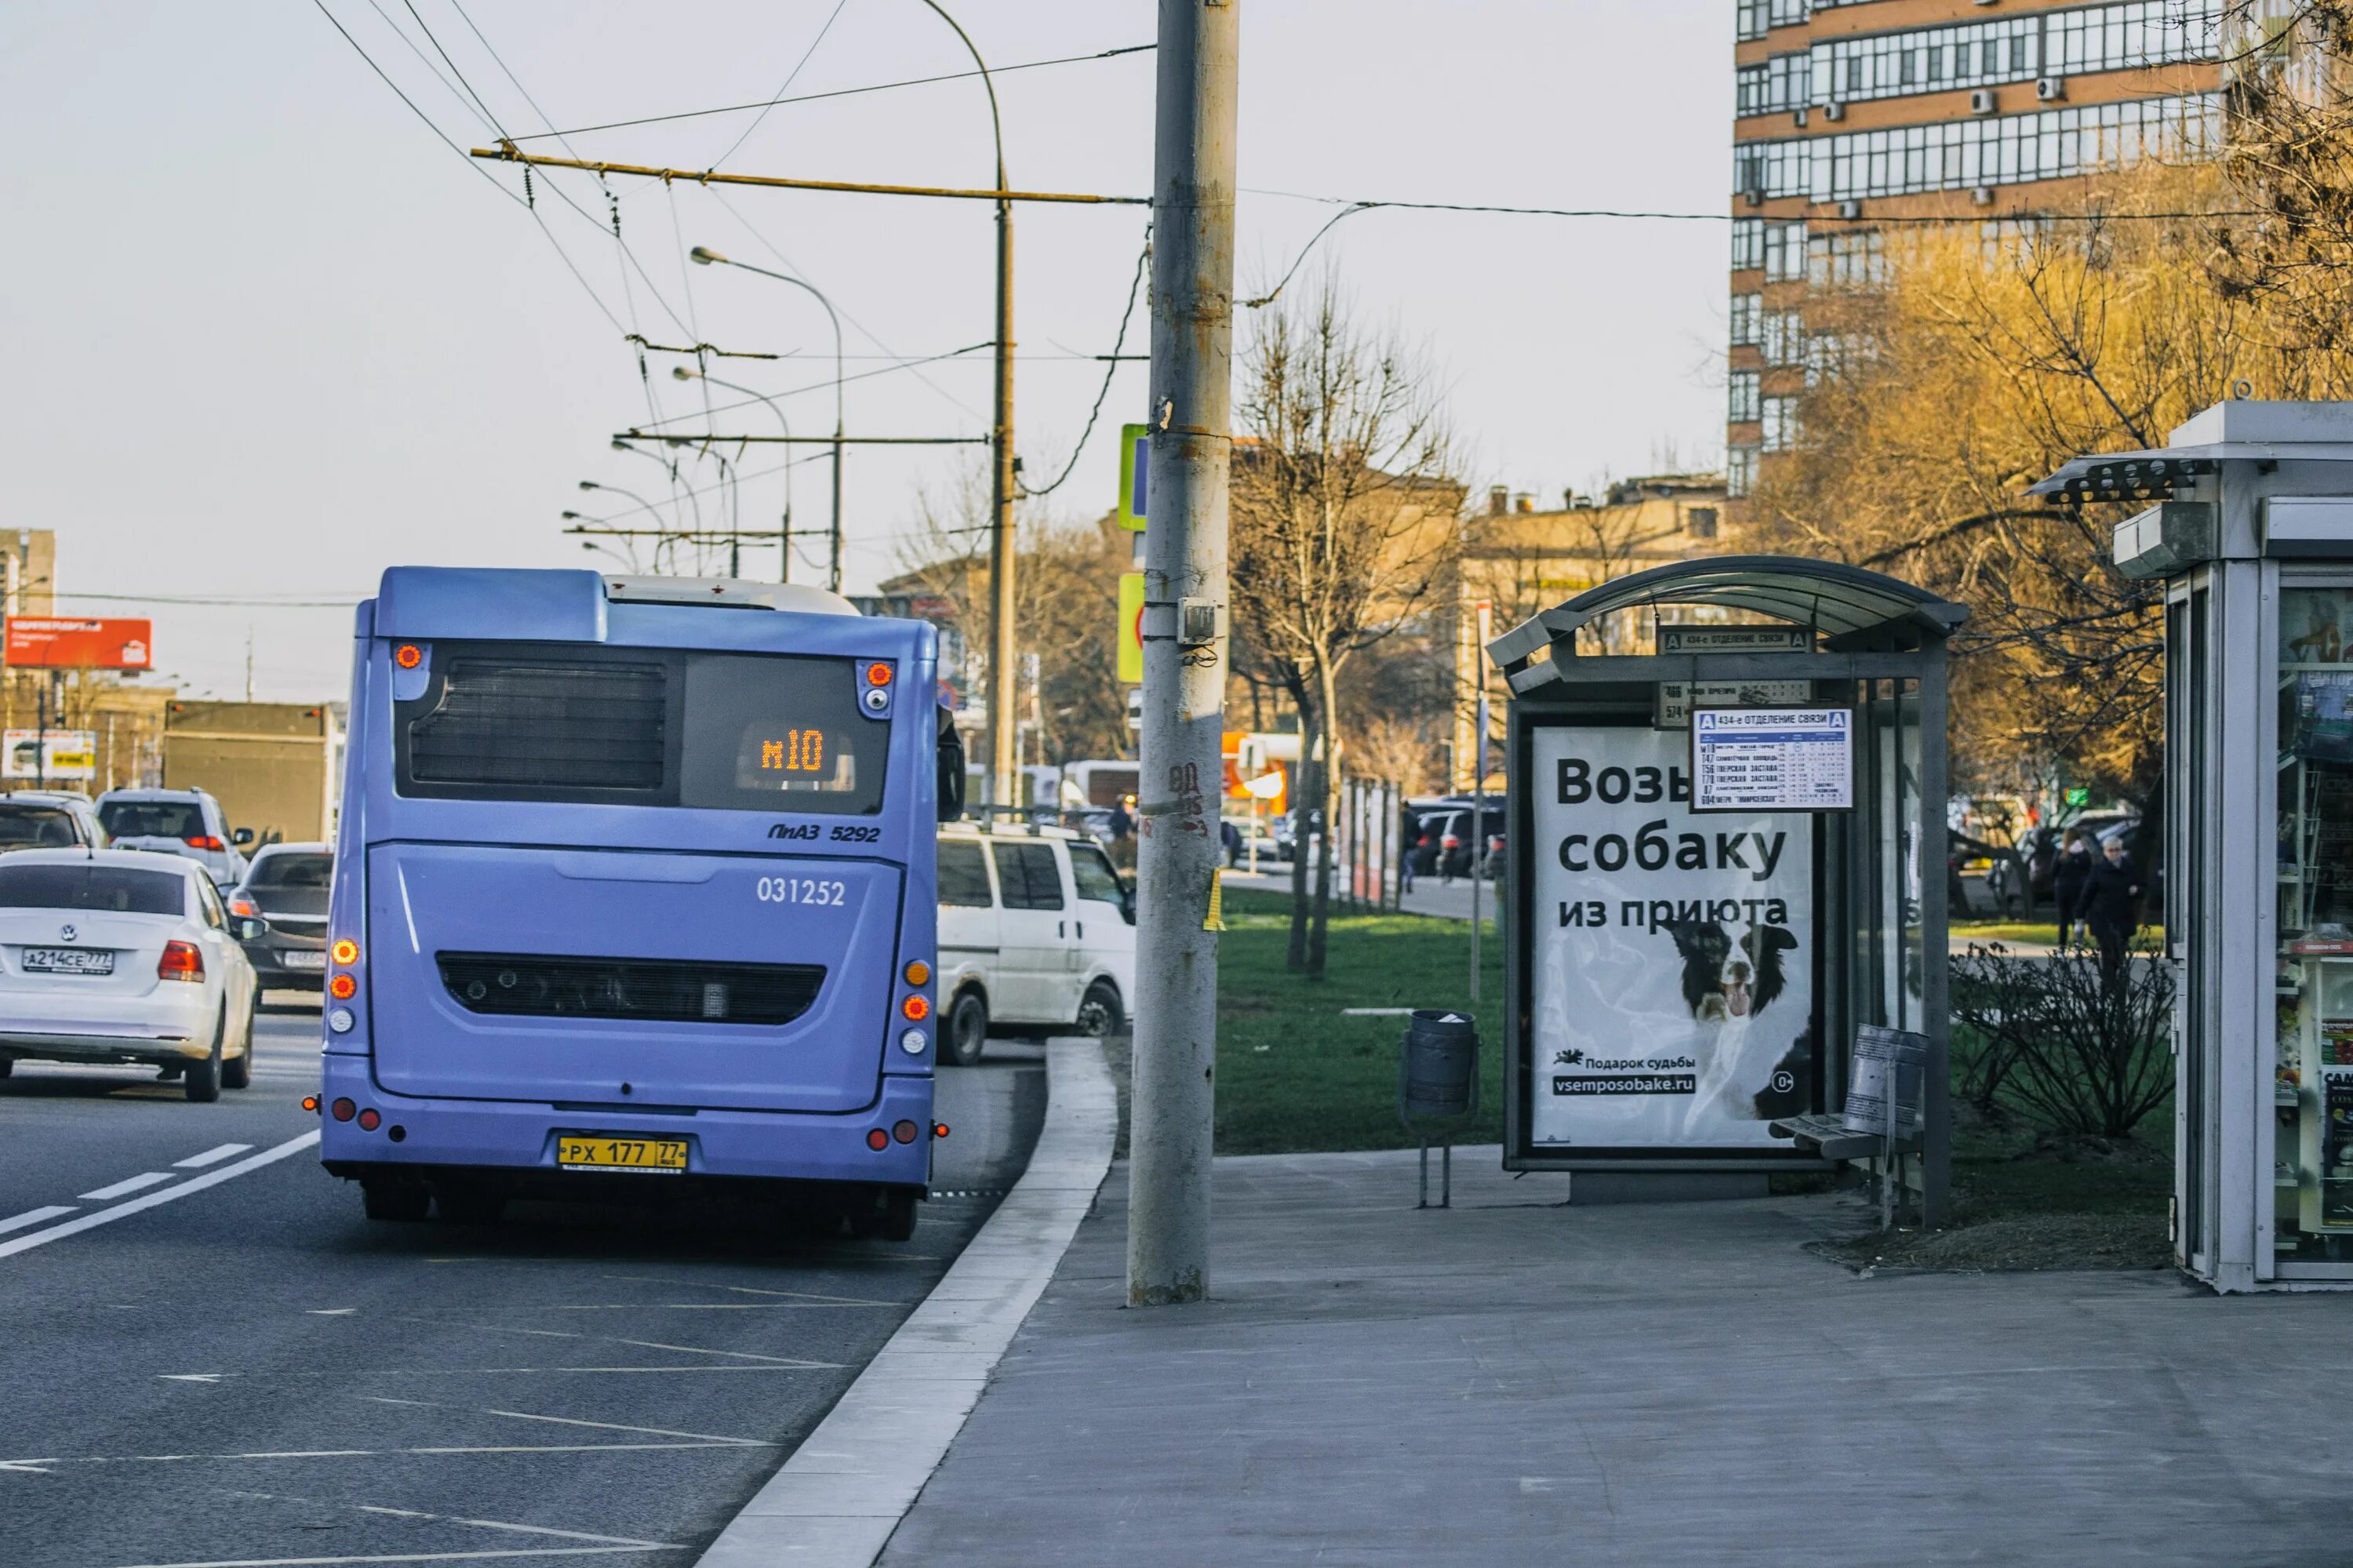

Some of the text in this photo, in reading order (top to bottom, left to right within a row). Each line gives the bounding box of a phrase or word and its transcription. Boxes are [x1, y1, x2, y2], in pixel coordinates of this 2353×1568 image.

[1711, 634, 1755, 644] ОТДЕЛЕНИЕ
[1758, 634, 1784, 643] СВЯЗИ
[1718, 715, 1742, 726] 434-е
[1744, 714, 1796, 726] ОТДЕЛЕНИЕ
[1798, 713, 1827, 724] СВЯЗИ
[761, 729, 823, 771] м10
[1557, 758, 1689, 805] Возь
[830, 826, 881, 843] 5292
[1558, 818, 1787, 882] собаку
[757, 876, 846, 907] 031252
[1558, 897, 1788, 935] из приюта
[1585, 1056, 1696, 1071] Подарок судьбы
[1555, 1075, 1694, 1095] vsemposobake.ru
[569, 1142, 679, 1163] РХ 177 77
